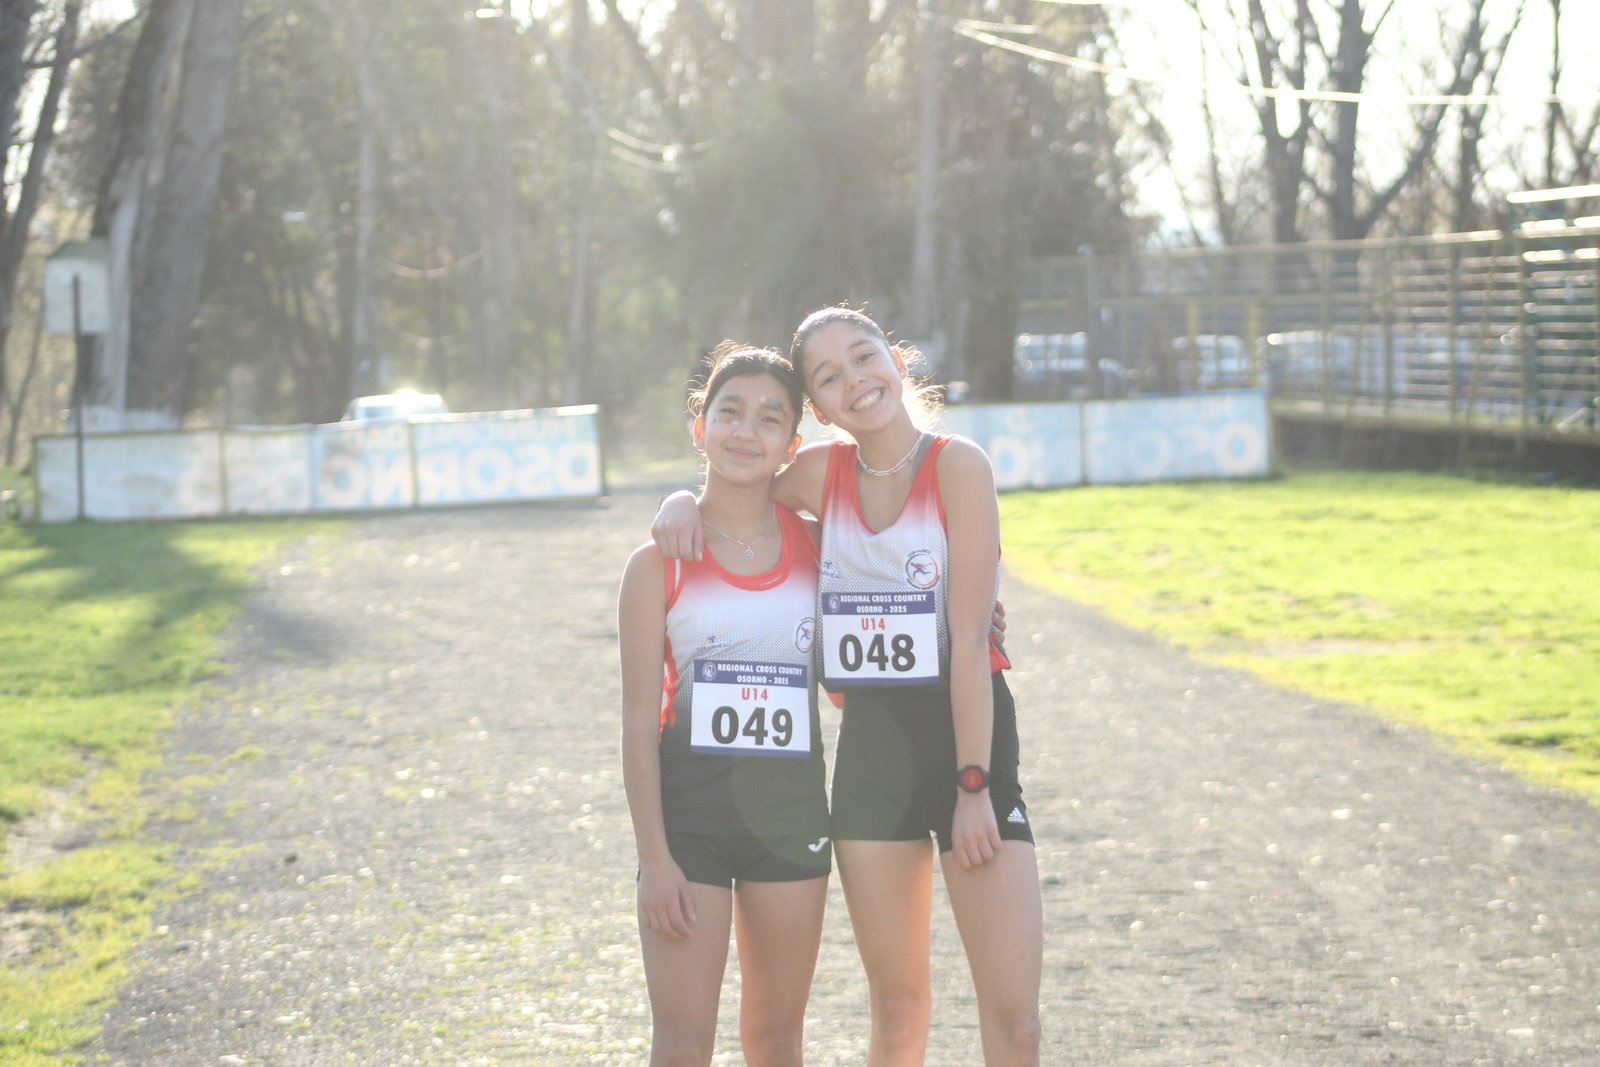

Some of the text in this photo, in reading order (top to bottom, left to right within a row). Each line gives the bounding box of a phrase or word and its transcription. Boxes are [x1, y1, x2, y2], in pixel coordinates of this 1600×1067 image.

[840, 593, 927, 603] REGIONAL CROSS COUNTRY
[856, 605, 883, 613] OSORNO
[889, 605, 907, 613] 2025
[861, 617, 886, 631] U14
[839, 633, 916, 672] 048
[717, 663, 802, 675] REGIONAL CROSS COUNTRY
[737, 675, 767, 684] OSORNO
[774, 676, 789, 685] 2025
[741, 687, 768, 701] U14
[711, 705, 793, 747] 049
